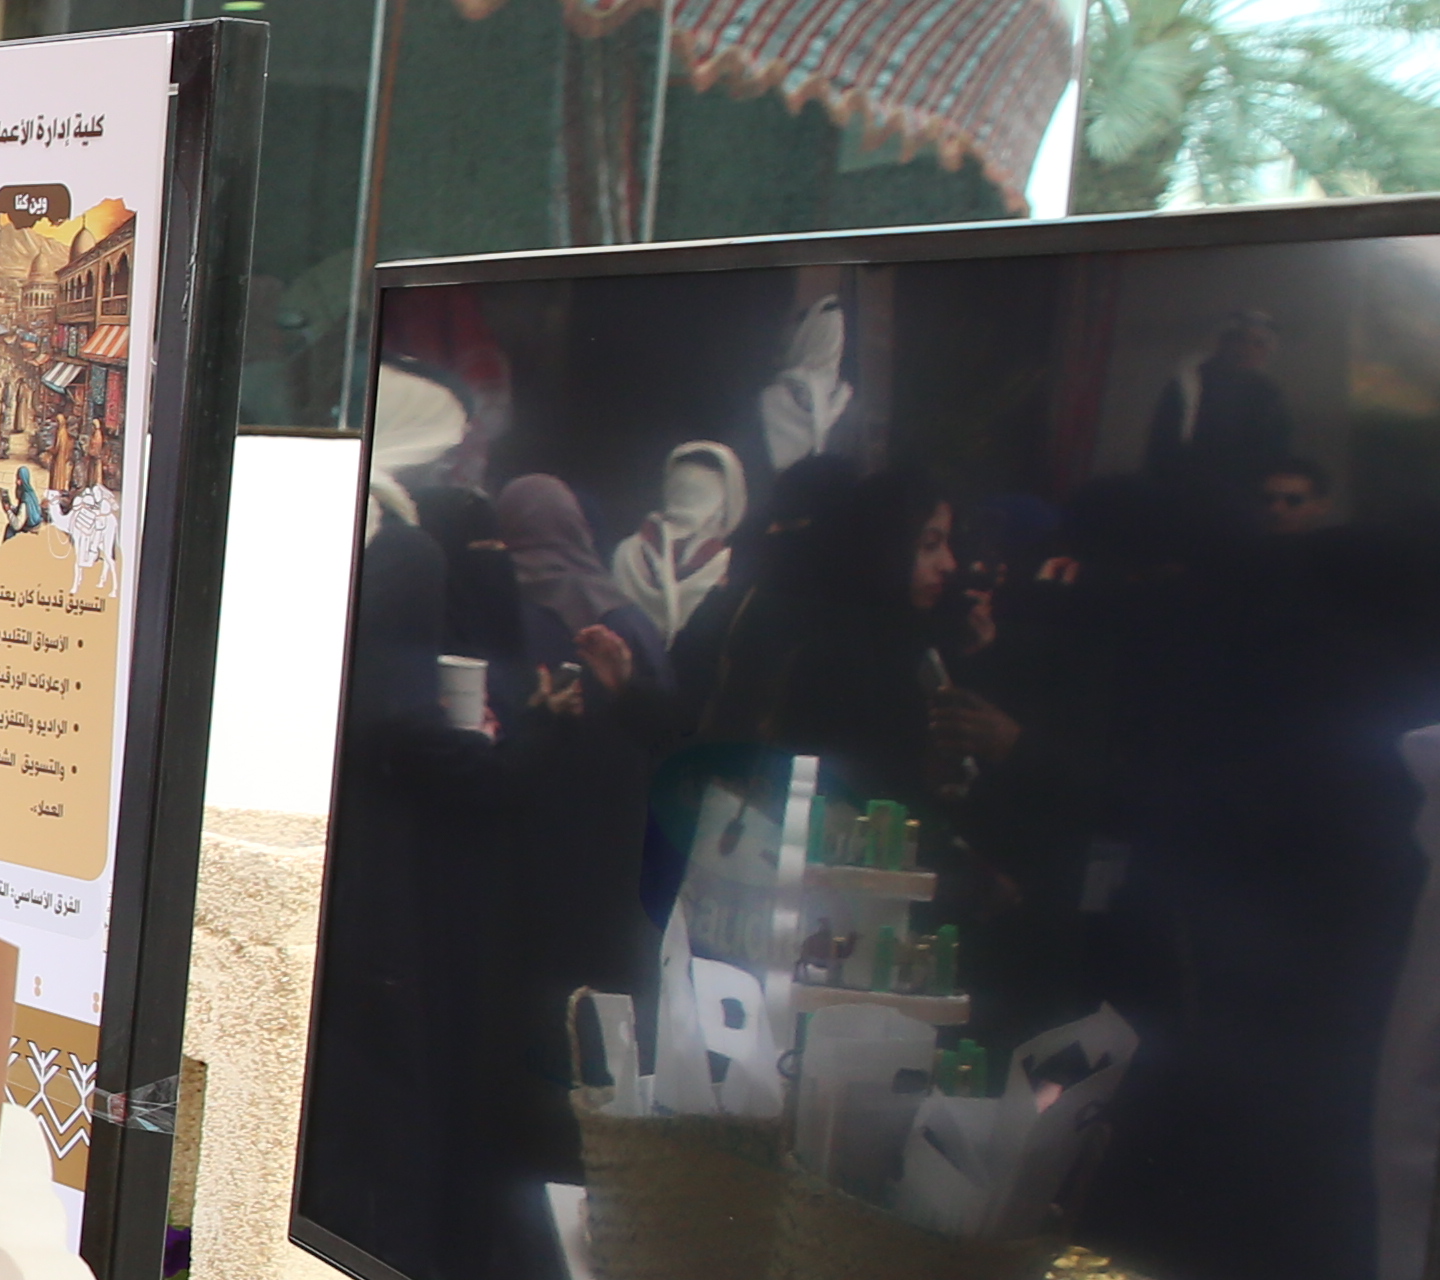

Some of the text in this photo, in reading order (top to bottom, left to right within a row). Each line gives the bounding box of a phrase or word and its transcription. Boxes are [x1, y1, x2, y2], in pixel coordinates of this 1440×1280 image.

[37, 114, 71, 147] إدارة
[73, 113, 105, 146] كلية
[14, 194, 48, 215] وين كنا
[17, 589, 34, 608] كان
[65, 591, 106, 616] التسويق
[33, 630, 69, 654] الأسواق
[28, 673, 70, 700] الإعلانات
[36, 717, 68, 739] الراديو
[20, 753, 65, 782] والتسويق
[54, 894, 80, 917] الفرق
